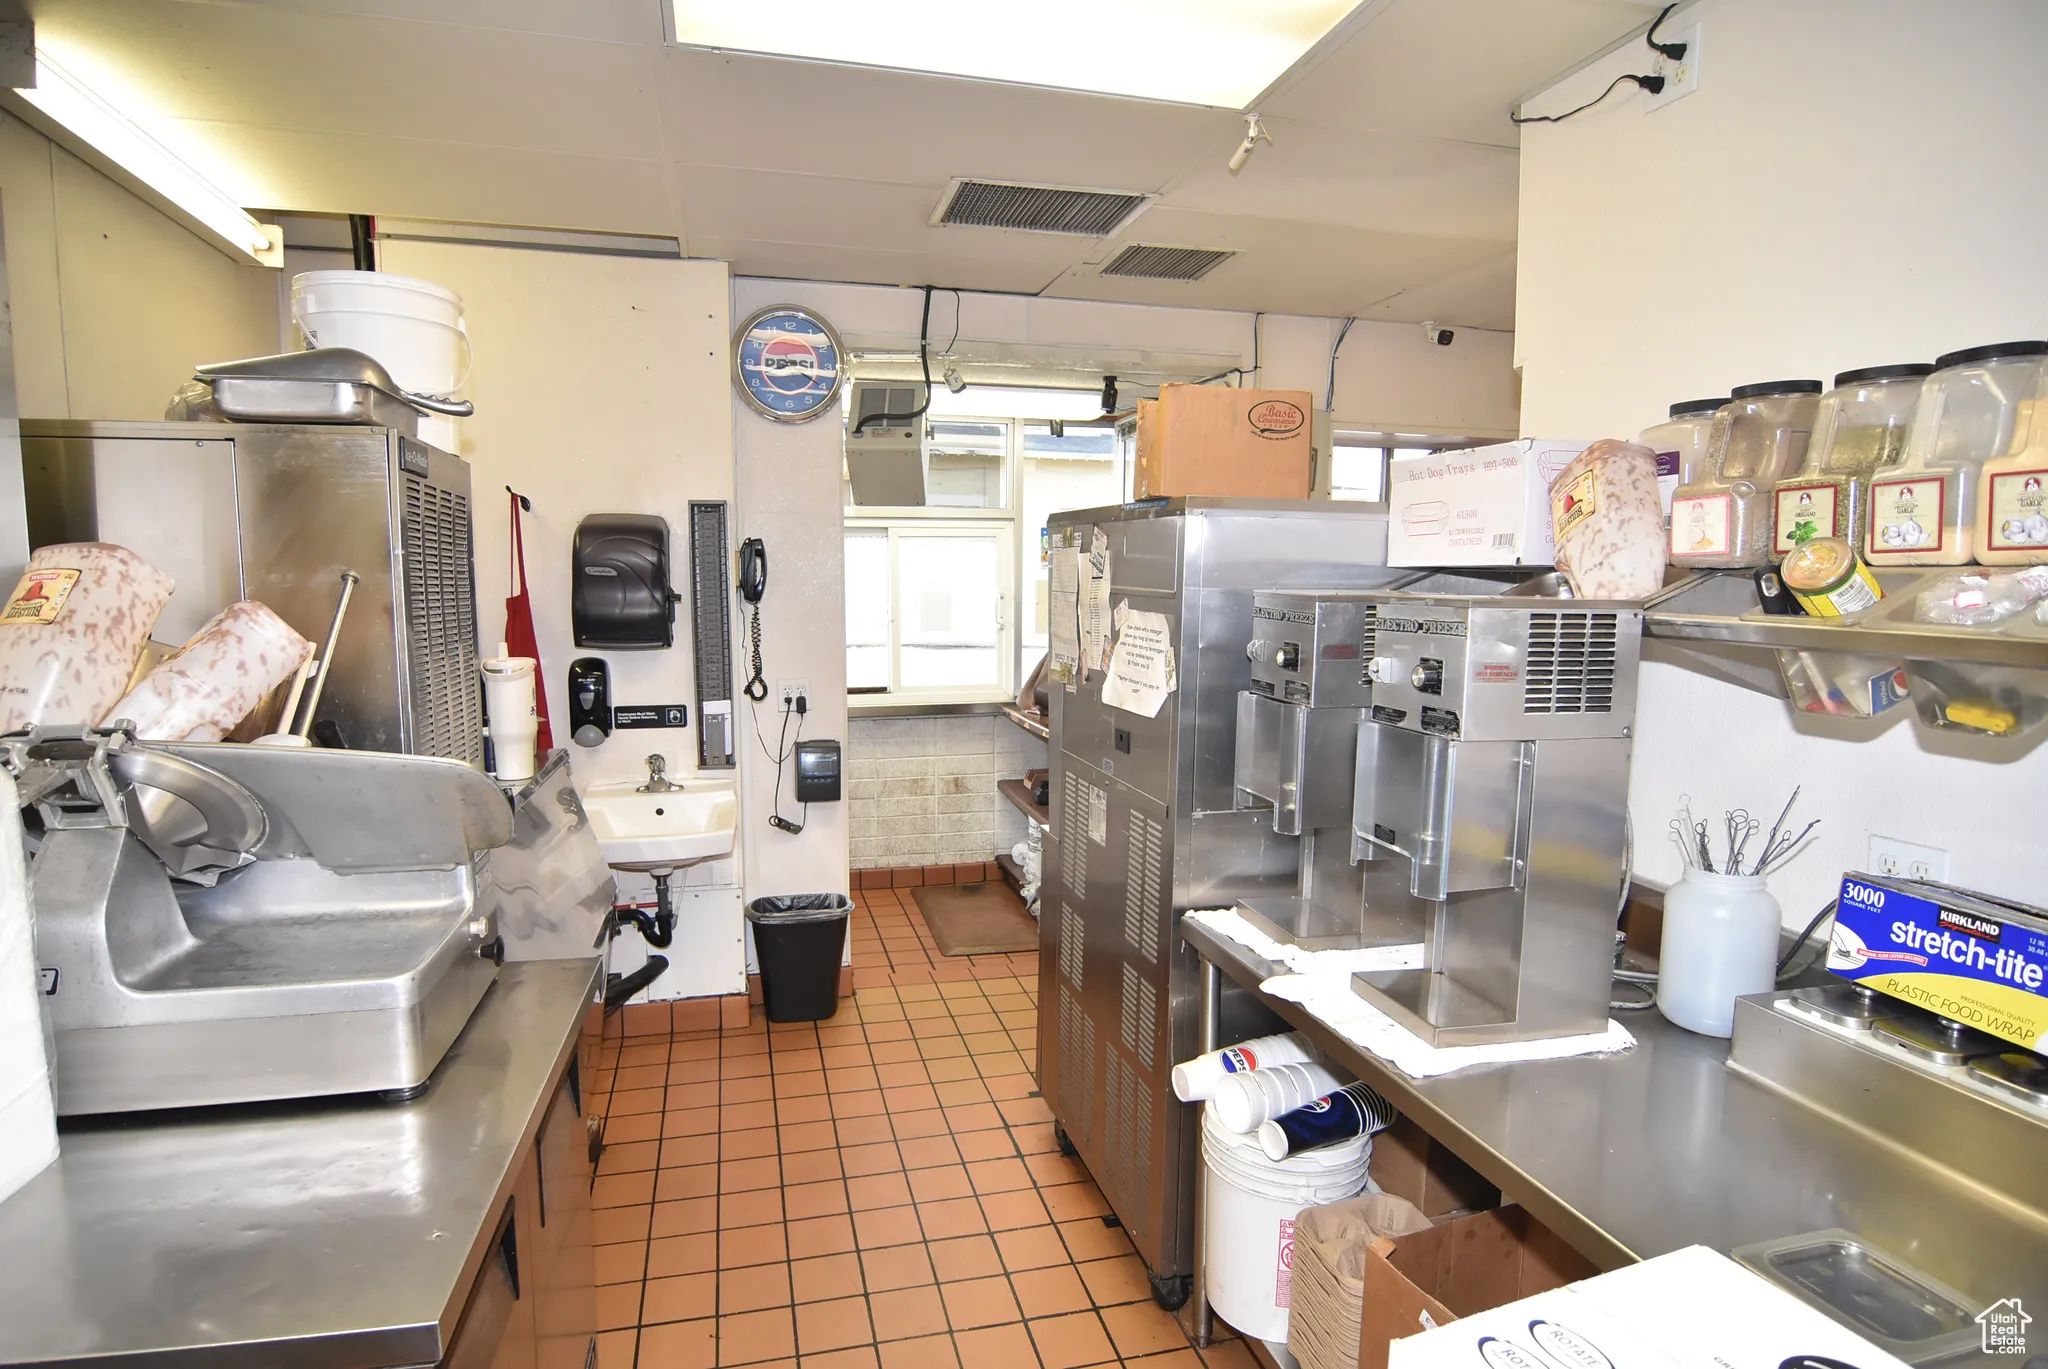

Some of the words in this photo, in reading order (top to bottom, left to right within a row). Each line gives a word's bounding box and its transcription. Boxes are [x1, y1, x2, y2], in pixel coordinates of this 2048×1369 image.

[784, 322, 796, 330] 12
[752, 341, 764, 349] 10
[819, 345, 827, 353] 2
[746, 359, 754, 367] 9
[764, 358, 814, 369] PEPSI
[752, 379, 760, 387] 8
[819, 382, 827, 390] 4
[785, 400, 794, 408] 6
[1266, 405, 1297, 419] Basic
[1409, 469, 1425, 481] Hot
[1427, 467, 1444, 479] Dog
[1446, 463, 1476, 476] Trays
[1483, 456, 1518, 472] HDT-500
[1456, 509, 1477, 520] 6X500
[1448, 537, 1483, 547] CONTAINERS
[1253, 607, 1283, 620] ELECTRO
[1285, 610, 1315, 624] FREEZE
[1375, 619, 1419, 633] ELECTRO
[1422, 621, 1466, 635] FREEZE
[1844, 883, 1885, 908] 3000
[1844, 898, 1866, 910] SQUARE
[1867, 905, 1882, 914] FEET
[1940, 910, 2000, 936] KIRKLAND
[2029, 937, 2037, 945] 12
[1890, 920, 2044, 988] stretch-tite
[1887, 978, 1940, 1008] PLASTIC
[1940, 998, 1983, 1023] FOOD
[1987, 1014, 2035, 1041] WRAP
[1960, 995, 2005, 1016] PROFESSIONAL
[2006, 1011, 2036, 1027] QUALITY
[1549, 1330, 1601, 1367] ROTATE
